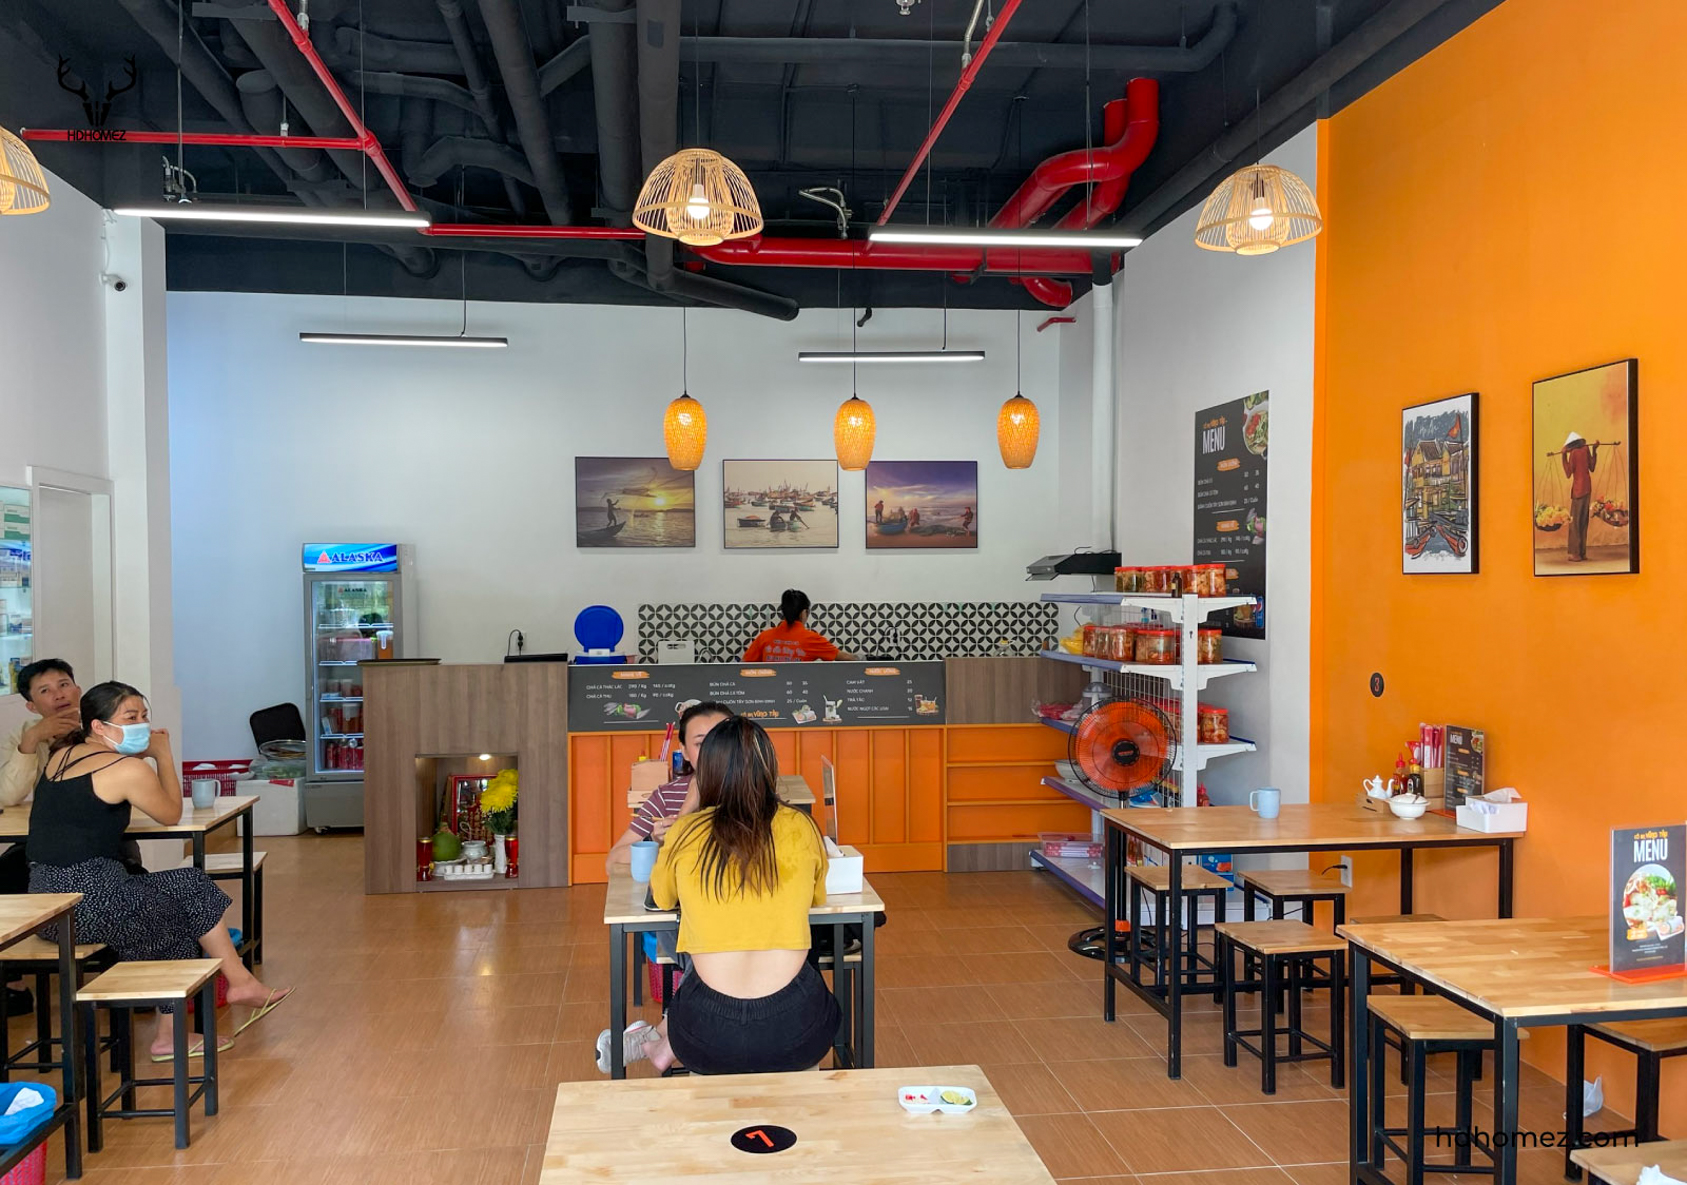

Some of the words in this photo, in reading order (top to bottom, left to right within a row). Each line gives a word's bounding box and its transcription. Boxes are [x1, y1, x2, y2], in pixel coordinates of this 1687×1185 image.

[1202, 426, 1226, 454] MENU
[331, 552, 383, 562] ALASKA
[1375, 677, 1380, 692] 3
[1450, 734, 1463, 745] MENU
[1634, 839, 1668, 863] MENU
